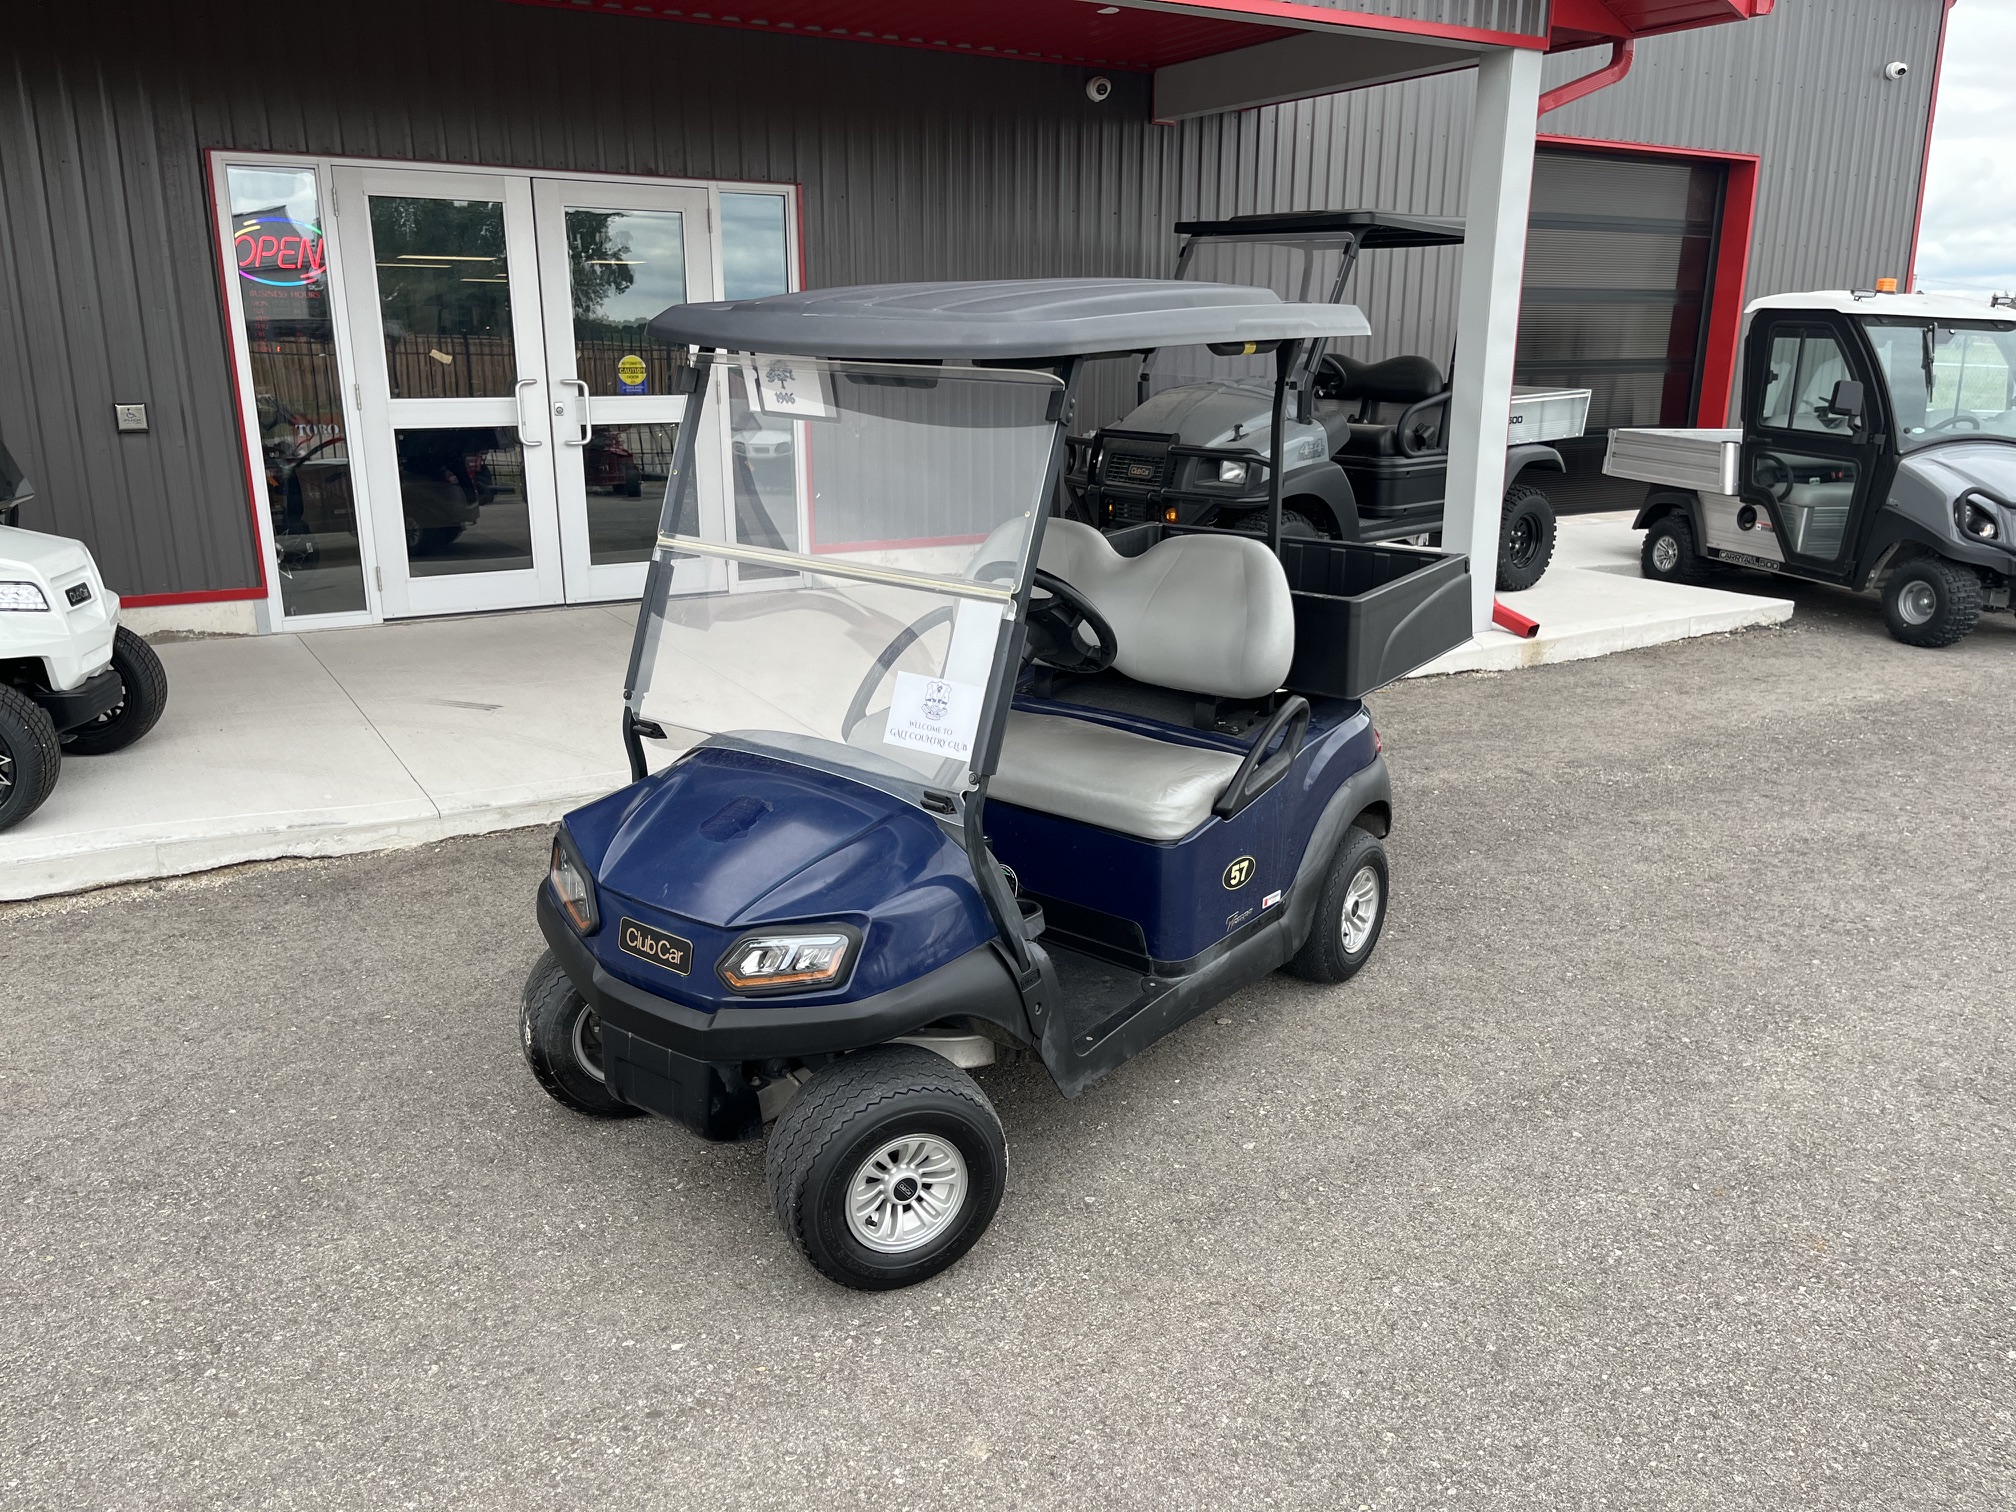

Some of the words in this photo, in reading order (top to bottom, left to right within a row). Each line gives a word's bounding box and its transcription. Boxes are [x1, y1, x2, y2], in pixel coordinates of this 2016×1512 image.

[235, 235, 324, 269] OPEN
[249, 290, 288, 298] BUSINESS
[290, 291, 321, 299] HOURS
[774, 391, 796, 405] 1906
[294, 424, 340, 437] TORO
[1720, 551, 1758, 567] CARRYALL
[908, 720, 941, 734] WELCOME
[943, 728, 953, 736] TO
[890, 727, 909, 741] GALT
[909, 732, 946, 749] COUNTRY
[948, 740, 968, 752] CLUB
[1230, 859, 1249, 886] 57
[626, 927, 656, 955] Club
[657, 940, 684, 965] Car
